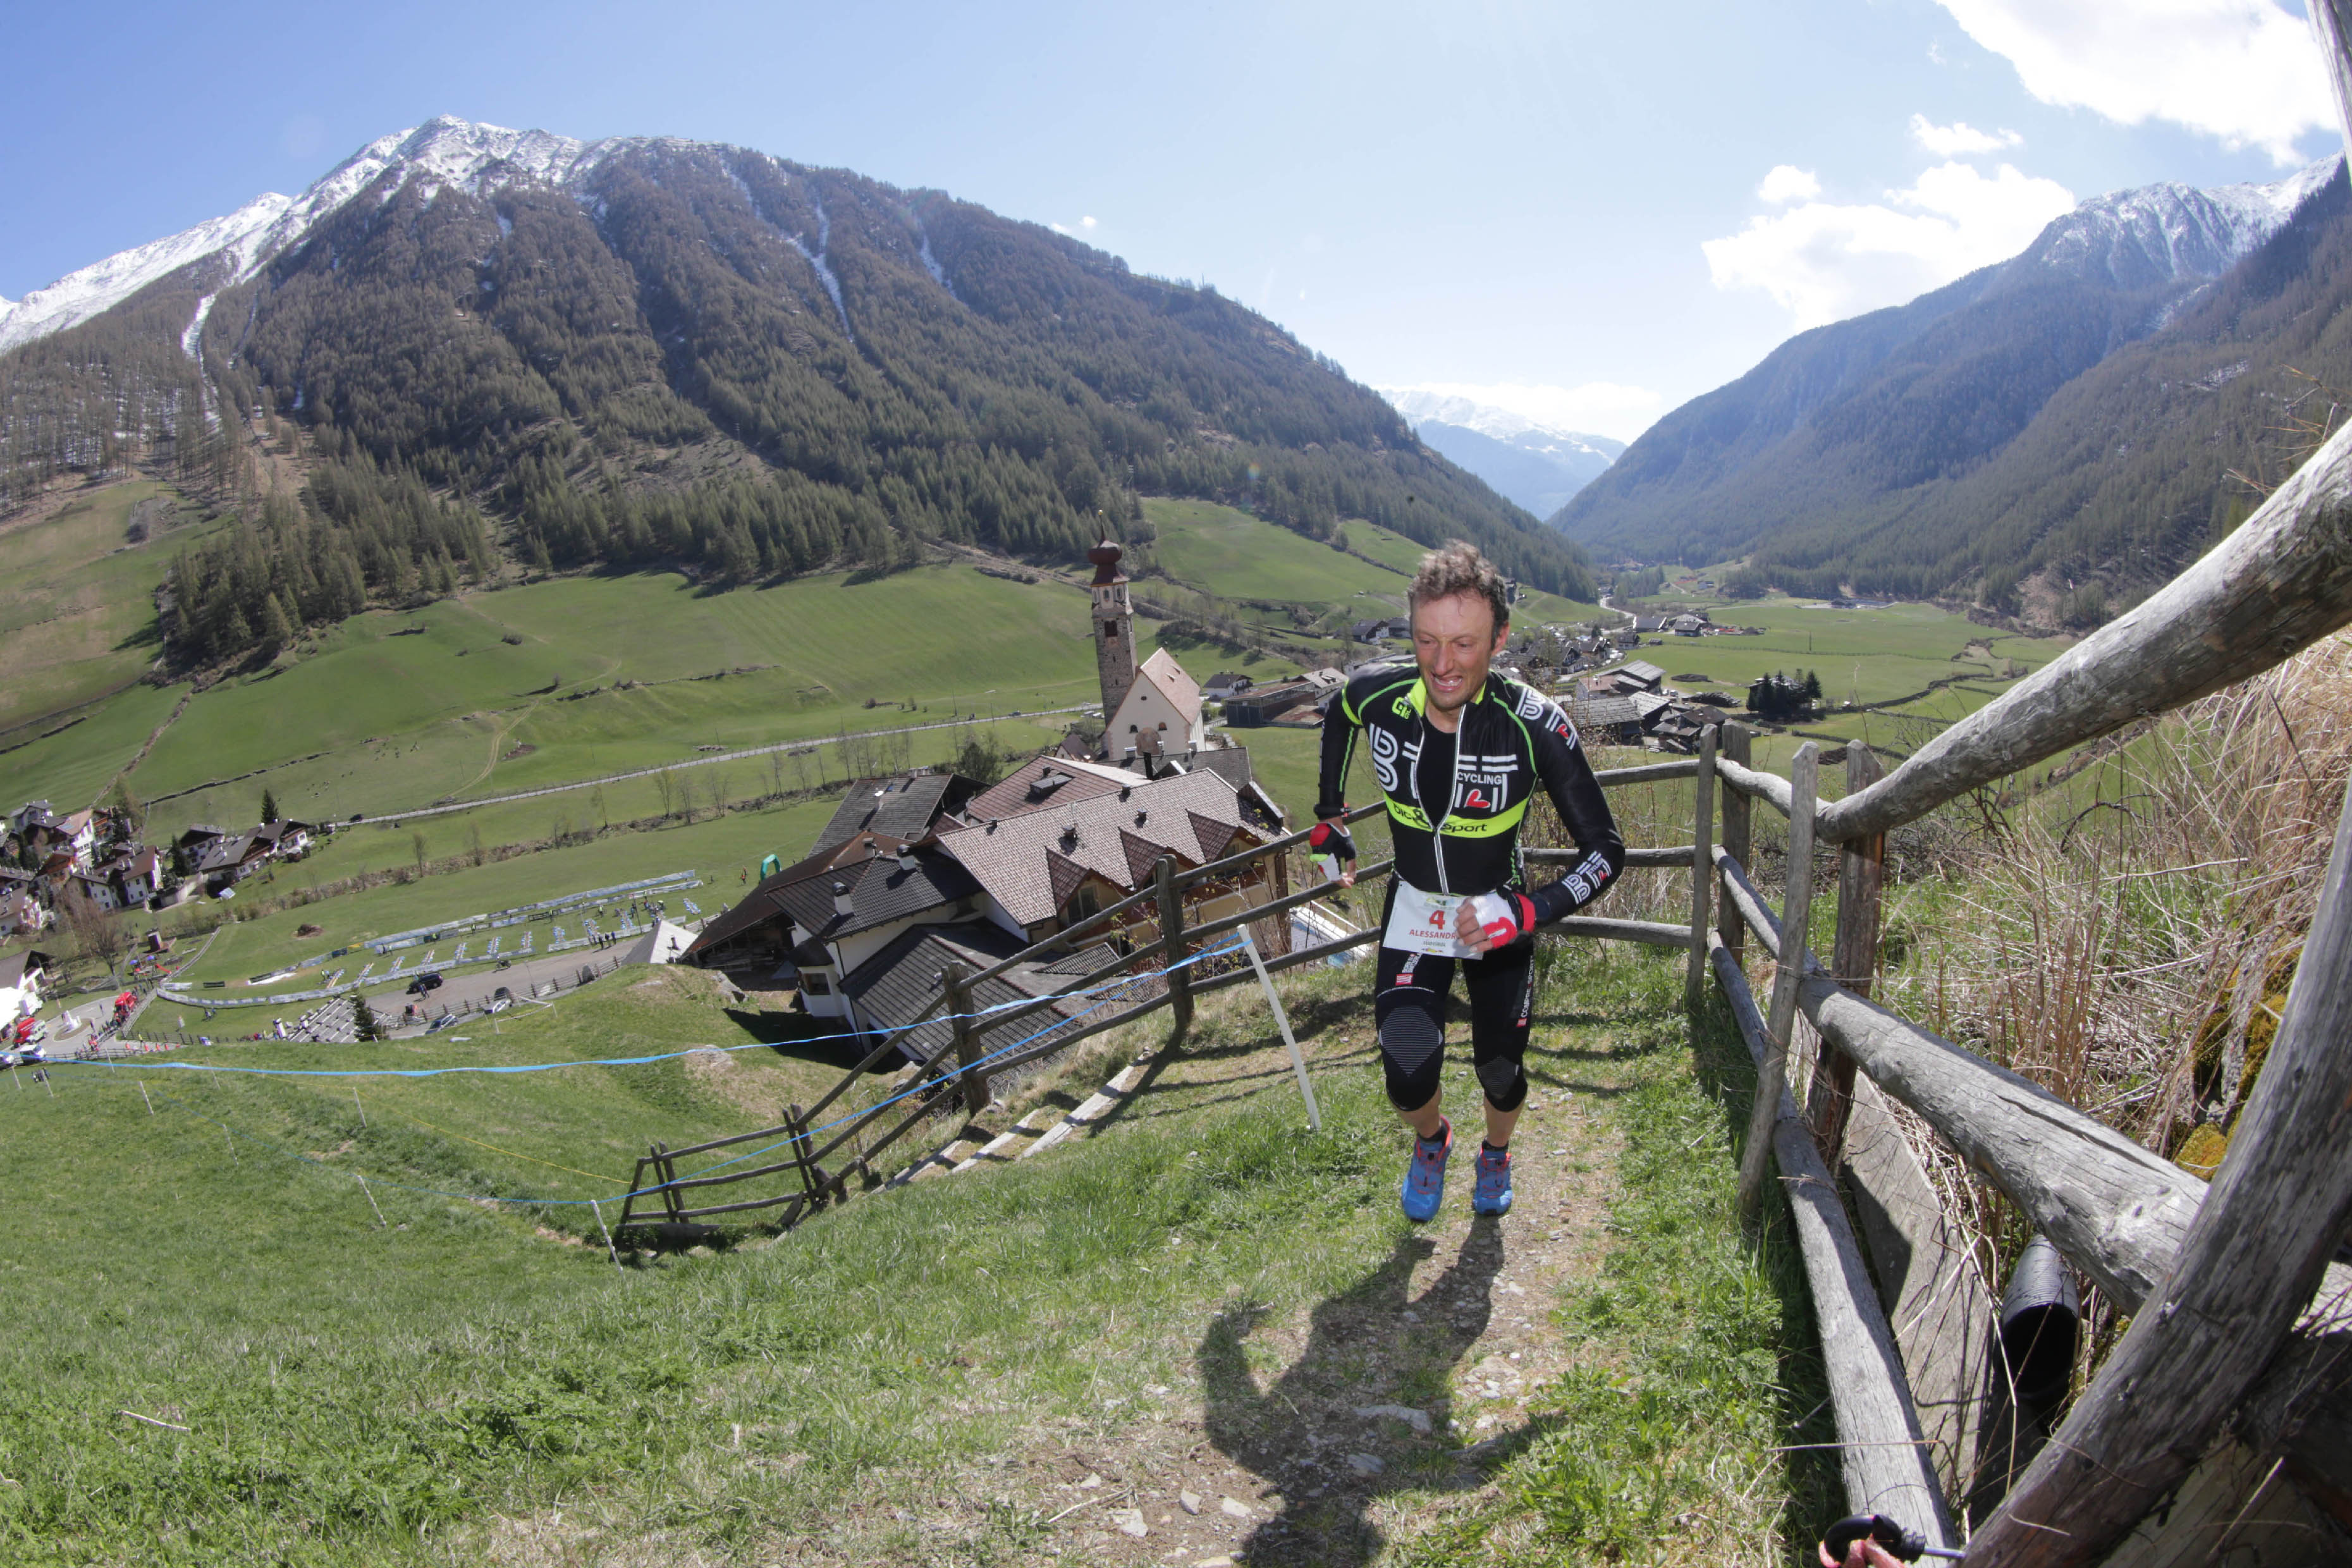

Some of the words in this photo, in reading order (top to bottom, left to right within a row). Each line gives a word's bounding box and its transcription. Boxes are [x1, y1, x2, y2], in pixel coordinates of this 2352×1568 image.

[1455, 771, 1503, 785] CYCLING
[1429, 909, 1446, 930] 4
[1409, 928, 1457, 940] ALESSANDR
